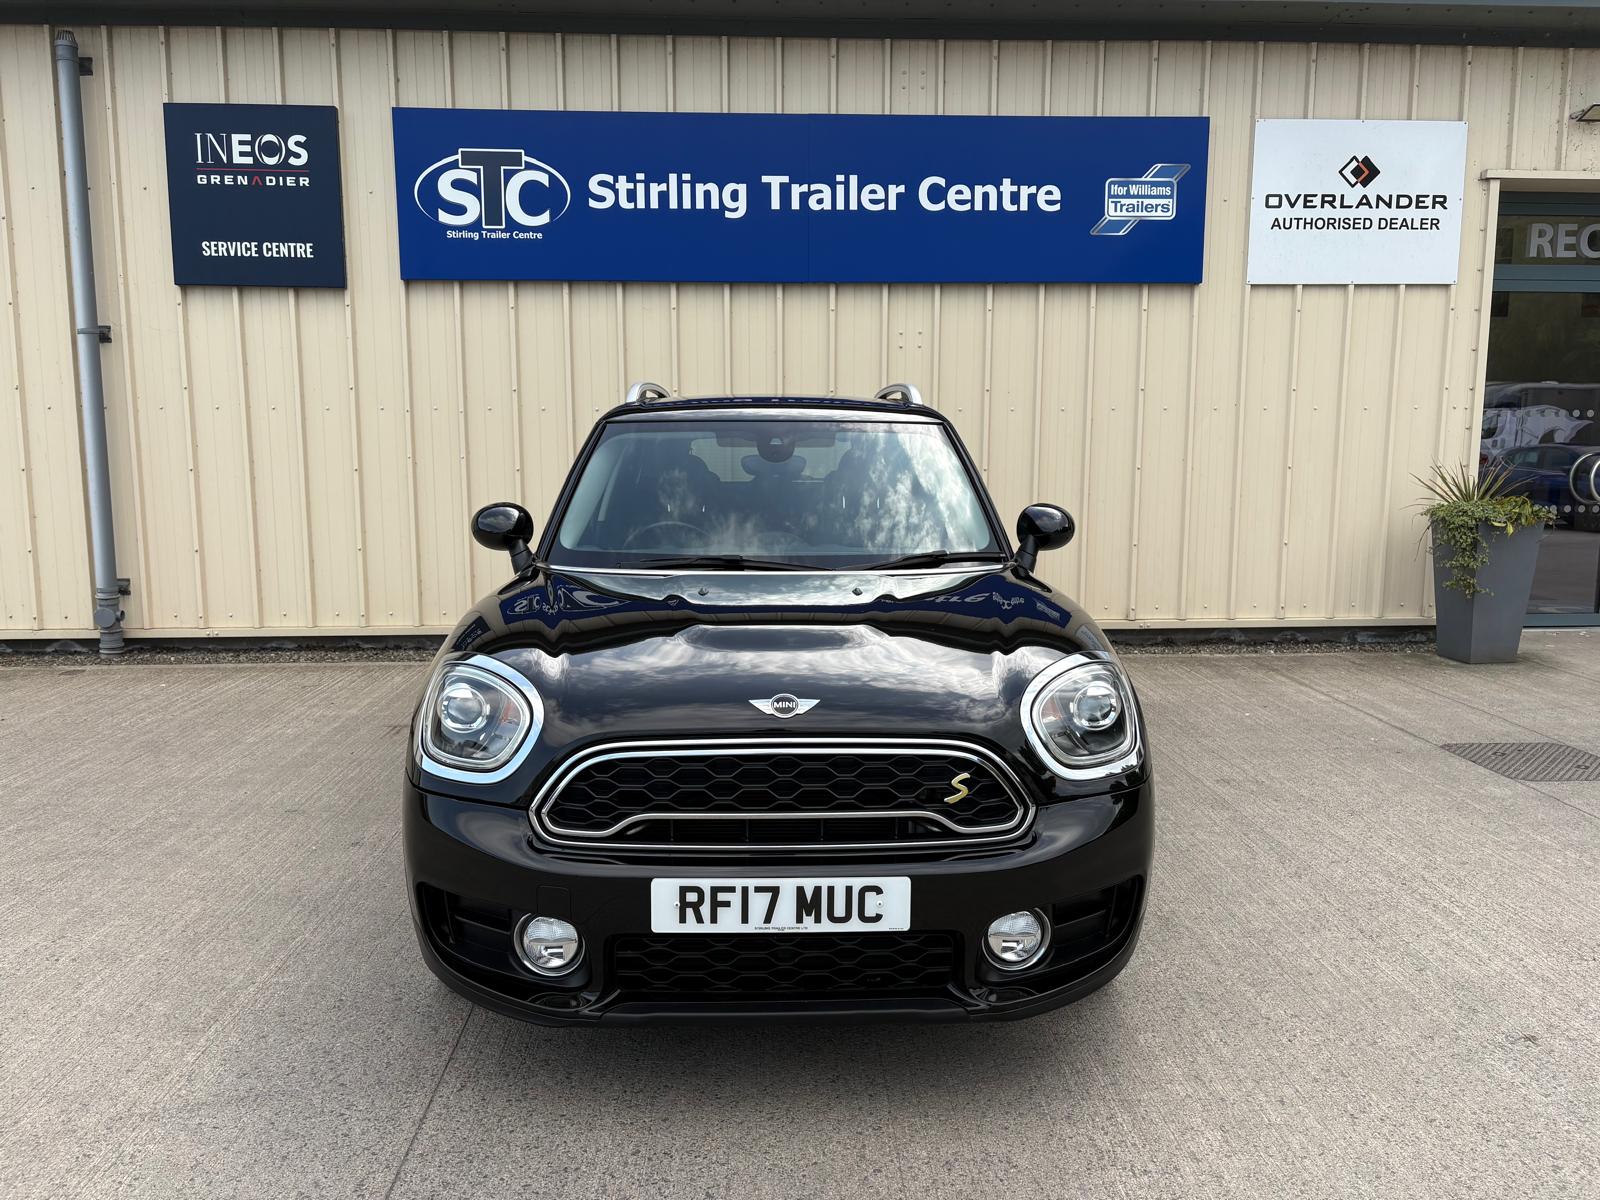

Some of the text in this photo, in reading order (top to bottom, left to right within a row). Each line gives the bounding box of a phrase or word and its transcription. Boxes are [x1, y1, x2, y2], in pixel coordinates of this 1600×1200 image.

[194, 132, 309, 166] INEOS
[196, 174, 310, 187] GRENADIER
[437, 148, 551, 228] STC
[588, 172, 1062, 219] Stirling Trailer Centre
[1111, 184, 1171, 196] Ifor Williams
[1110, 200, 1171, 213] Trailers
[1264, 193, 1449, 210] OVERLANDER
[1270, 217, 1441, 231] AUTHORISED DEALER
[446, 230, 543, 241] Stirling Trailer Centre
[201, 240, 315, 258] SERVICE CENTRE
[773, 700, 796, 709] MINI
[944, 772, 971, 804] S
[678, 885, 884, 924] RF17 MUC
